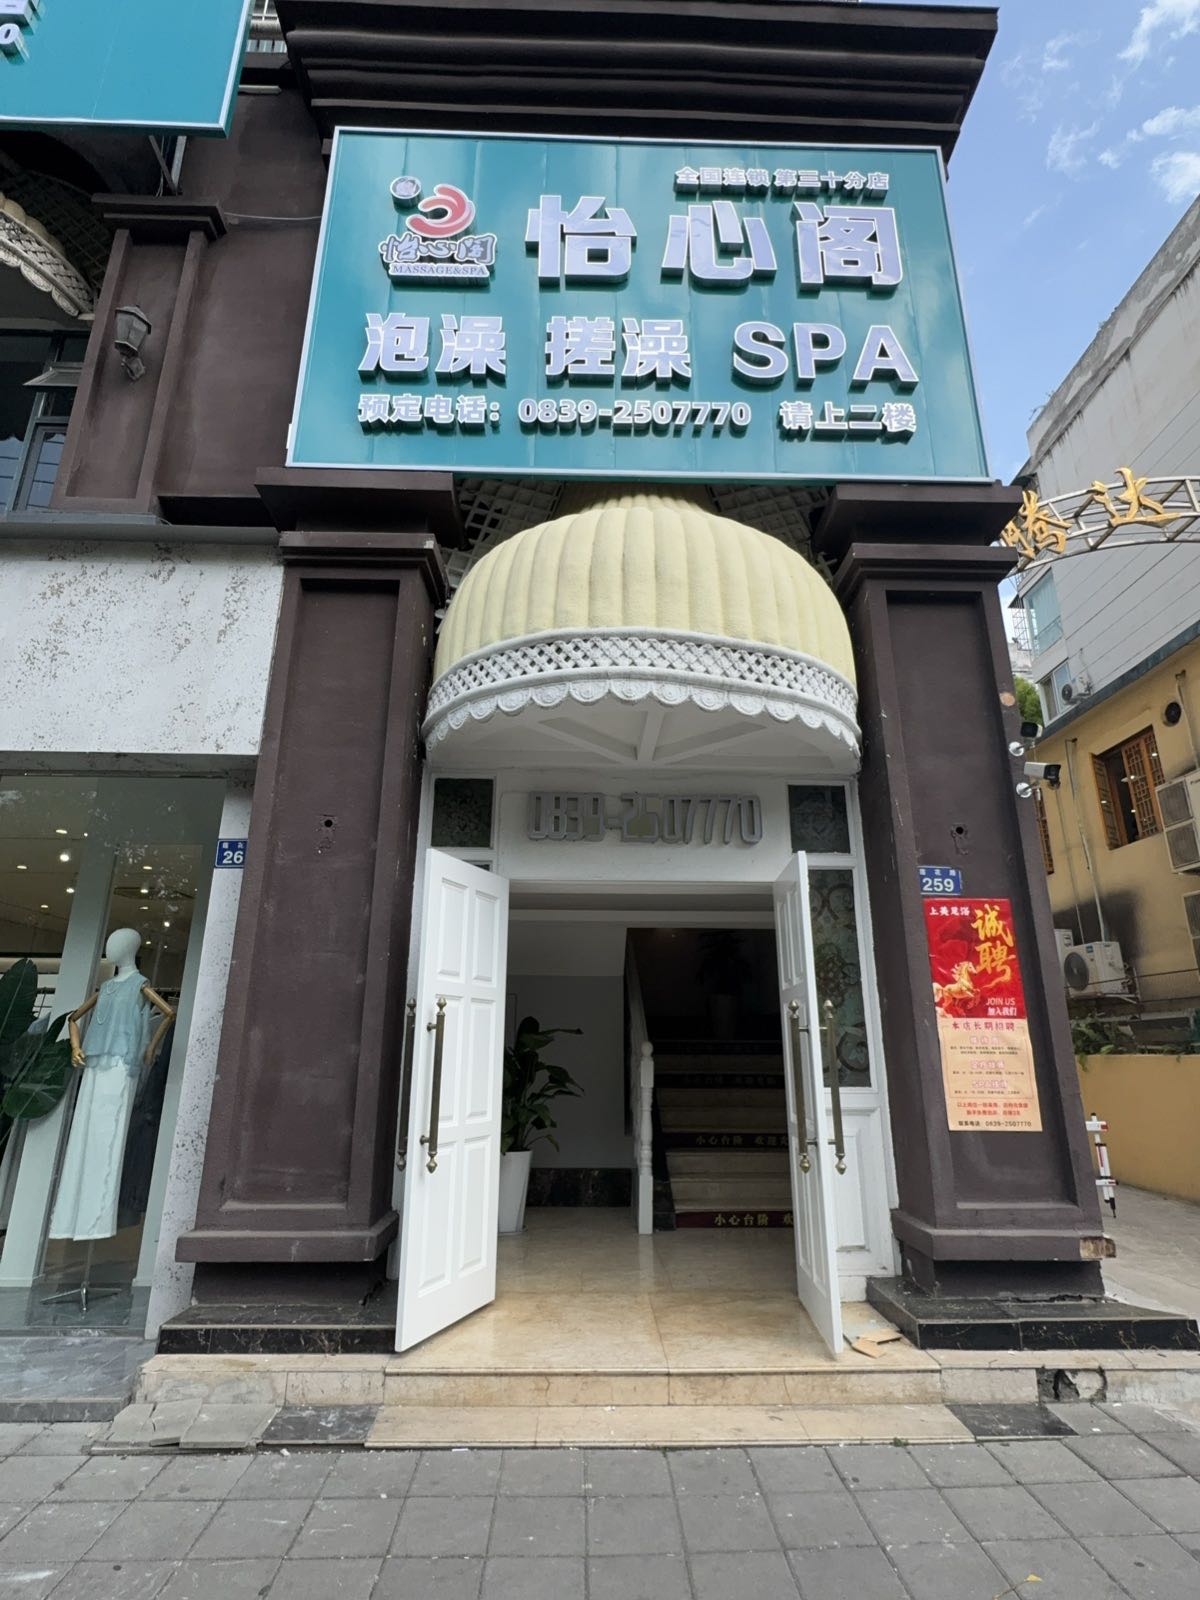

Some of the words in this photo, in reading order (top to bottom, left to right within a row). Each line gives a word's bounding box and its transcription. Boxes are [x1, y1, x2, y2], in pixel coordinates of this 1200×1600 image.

[675, 166, 769, 187] 全国连锁
[773, 168, 889, 190] 第三十分店
[378, 231, 498, 265] 怡心阁
[524, 194, 903, 289] 怡心阁
[392, 264, 487, 276] MASSAGE&SPA
[358, 313, 507, 375] 泡澡
[545, 315, 692, 379] 搓澡
[732, 321, 919, 383] SPA
[518, 398, 752, 427] 0839-2507770
[779, 401, 917, 432] 请上二楼
[222, 850, 244, 864] 26
[922, 877, 955, 892] 259
[970, 902, 1017, 986] 诚聘
[986, 997, 1004, 1006] JOIN
[1004, 997, 1016, 1006] US
[986, 1006, 1018, 1017] 加入我们
